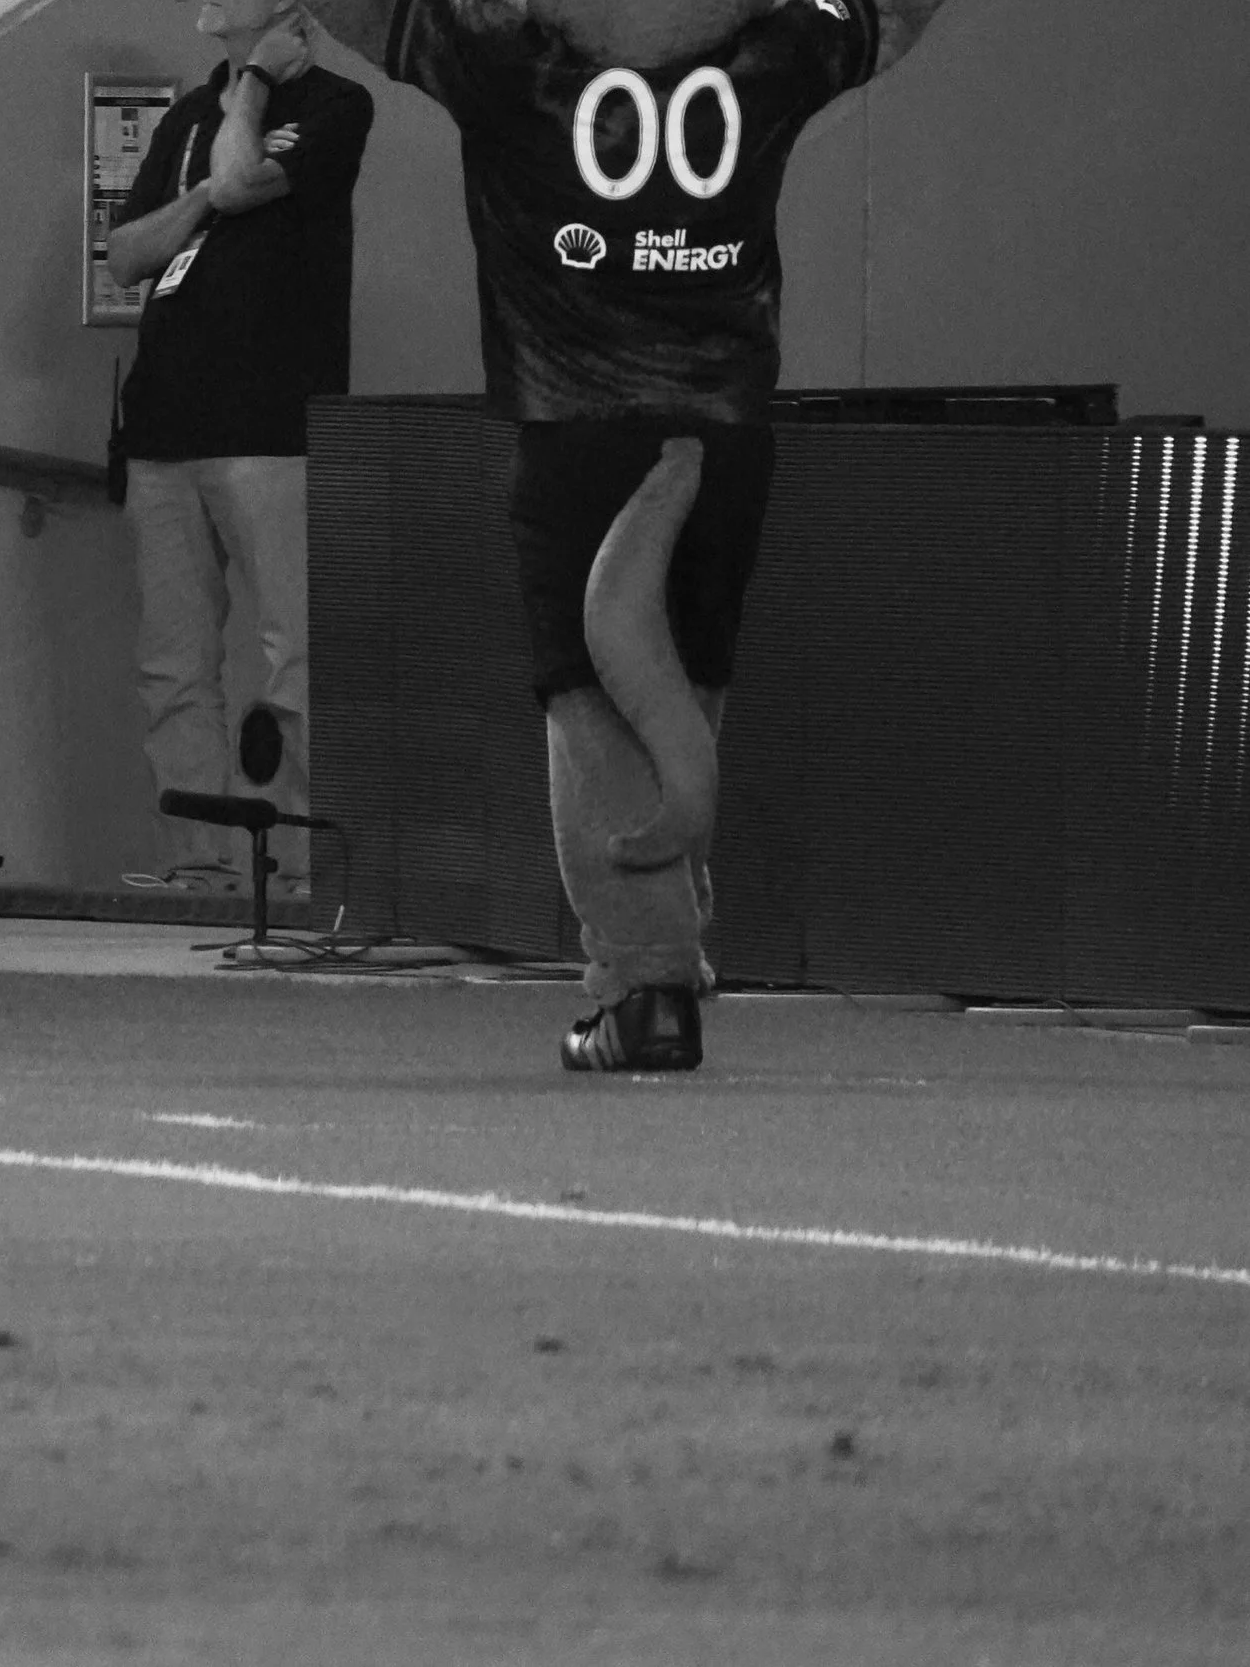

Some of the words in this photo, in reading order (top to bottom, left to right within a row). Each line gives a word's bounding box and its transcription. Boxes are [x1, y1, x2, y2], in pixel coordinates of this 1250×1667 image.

[573, 65, 742, 201] 00
[634, 228, 686, 249] Shell
[632, 240, 744, 272] ENERGY
